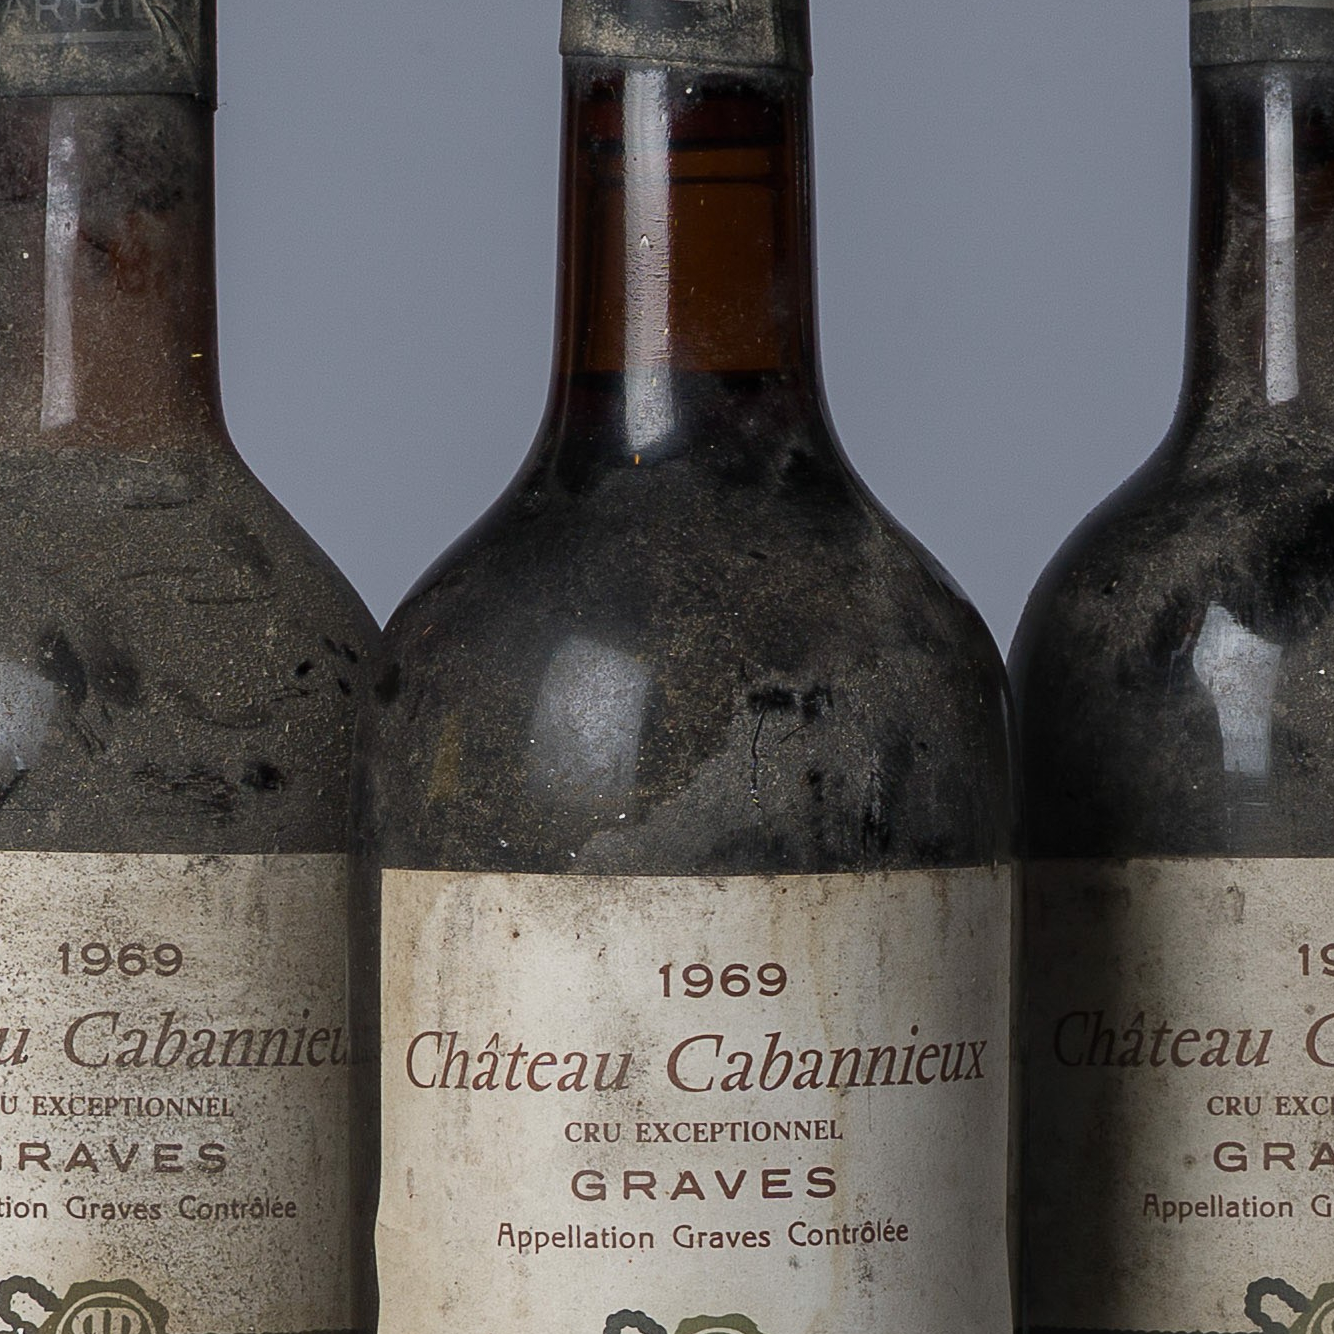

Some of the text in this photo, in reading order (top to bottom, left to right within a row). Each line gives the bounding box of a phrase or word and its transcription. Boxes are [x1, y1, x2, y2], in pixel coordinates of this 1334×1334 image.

[57, 941, 184, 977] 1969
[658, 962, 788, 999] 1969
[63, 1007, 348, 1068] Cabannieu
[1052, 1009, 1273, 1069] Château
[405, 1024, 989, 1094] Château Cabannieux
[31, 1094, 234, 1119] EXCEPTIONNEL
[1206, 1095, 1262, 1117] CRU
[563, 1119, 845, 1145] CRU EXCEPTIONNEL
[570, 1166, 838, 1202] GRAVES
[65, 1195, 162, 1221] Graves
[178, 1193, 297, 1220] Contrôlée
[1142, 1193, 1294, 1224] Appellation
[496, 1219, 910, 1255] Appellation Graves Contrôlée
